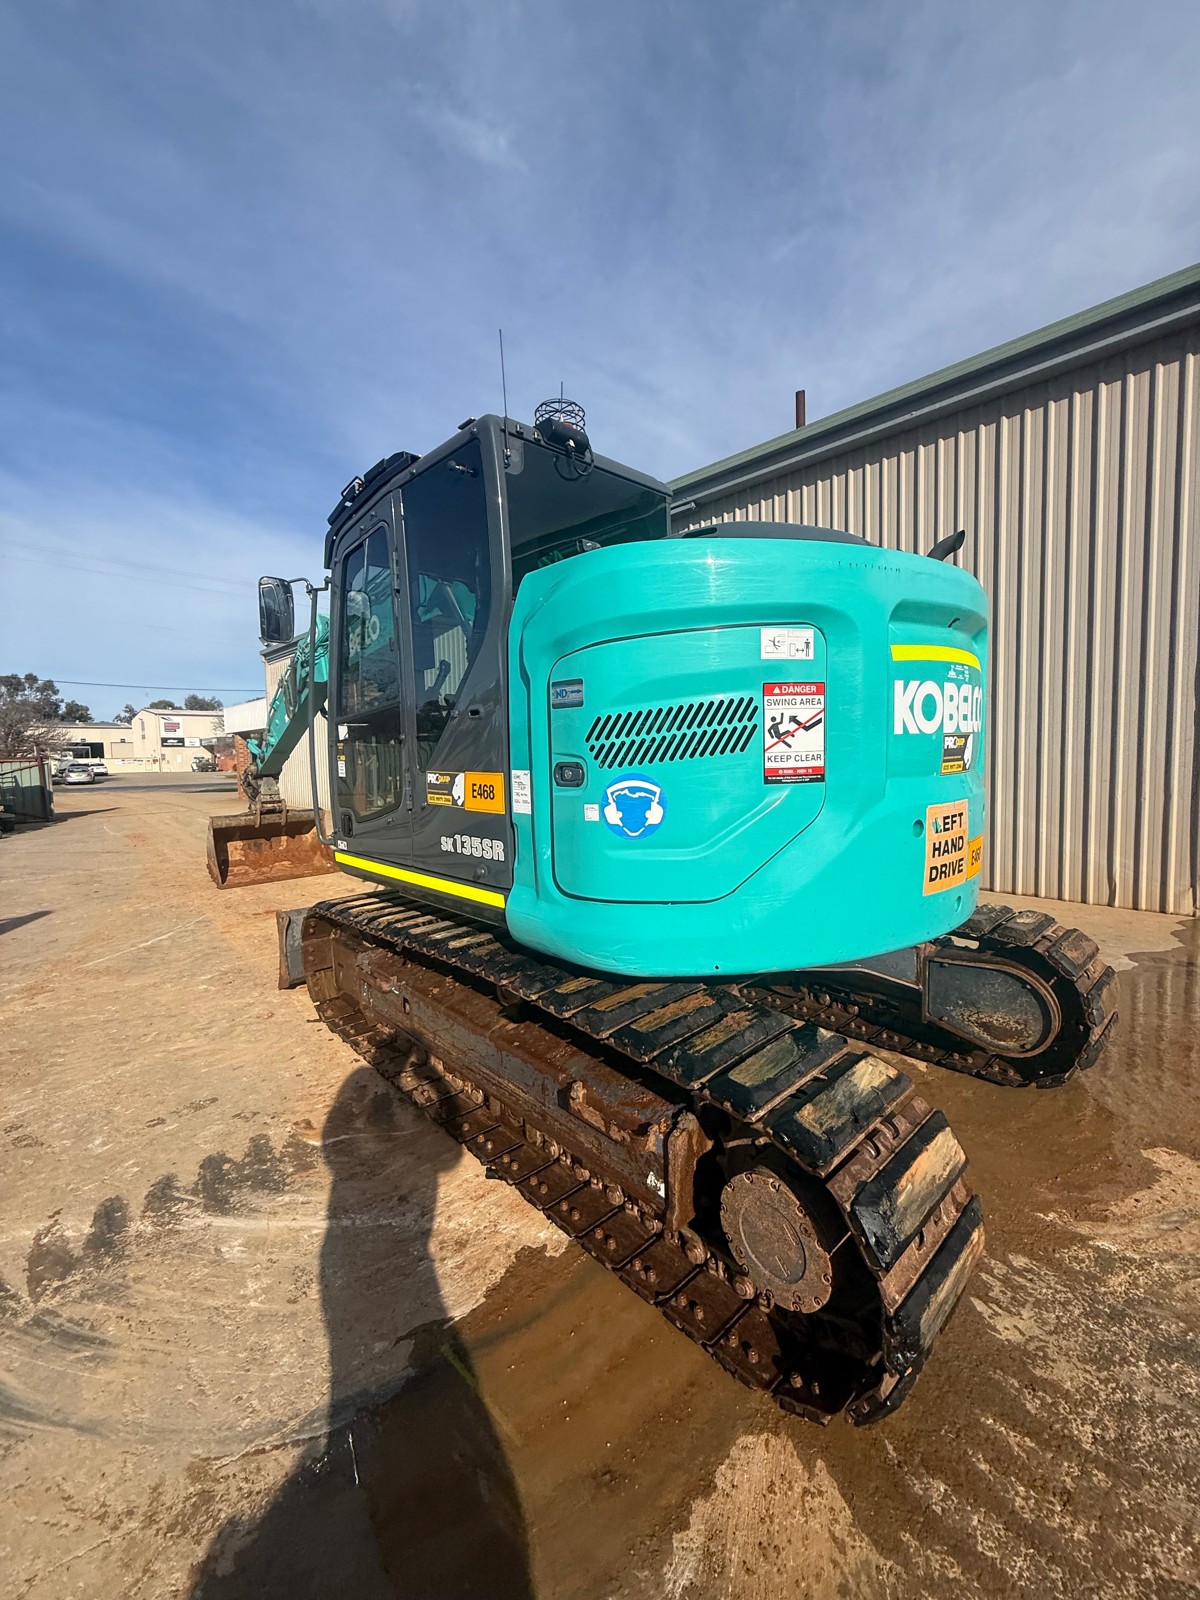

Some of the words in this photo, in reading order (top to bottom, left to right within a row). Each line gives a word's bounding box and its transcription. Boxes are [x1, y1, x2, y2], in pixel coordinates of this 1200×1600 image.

[782, 685, 816, 694] DANGER
[766, 698, 797, 707] SWING
[799, 697, 822, 706] AREA
[767, 755, 792, 764] KEEP
[794, 753, 822, 763] CLEAR
[471, 783, 495, 800] E468
[934, 812, 964, 834] LEFT
[440, 834, 505, 862] SK135SR
[932, 835, 964, 858] HAND
[928, 858, 964, 883] DRIVE
